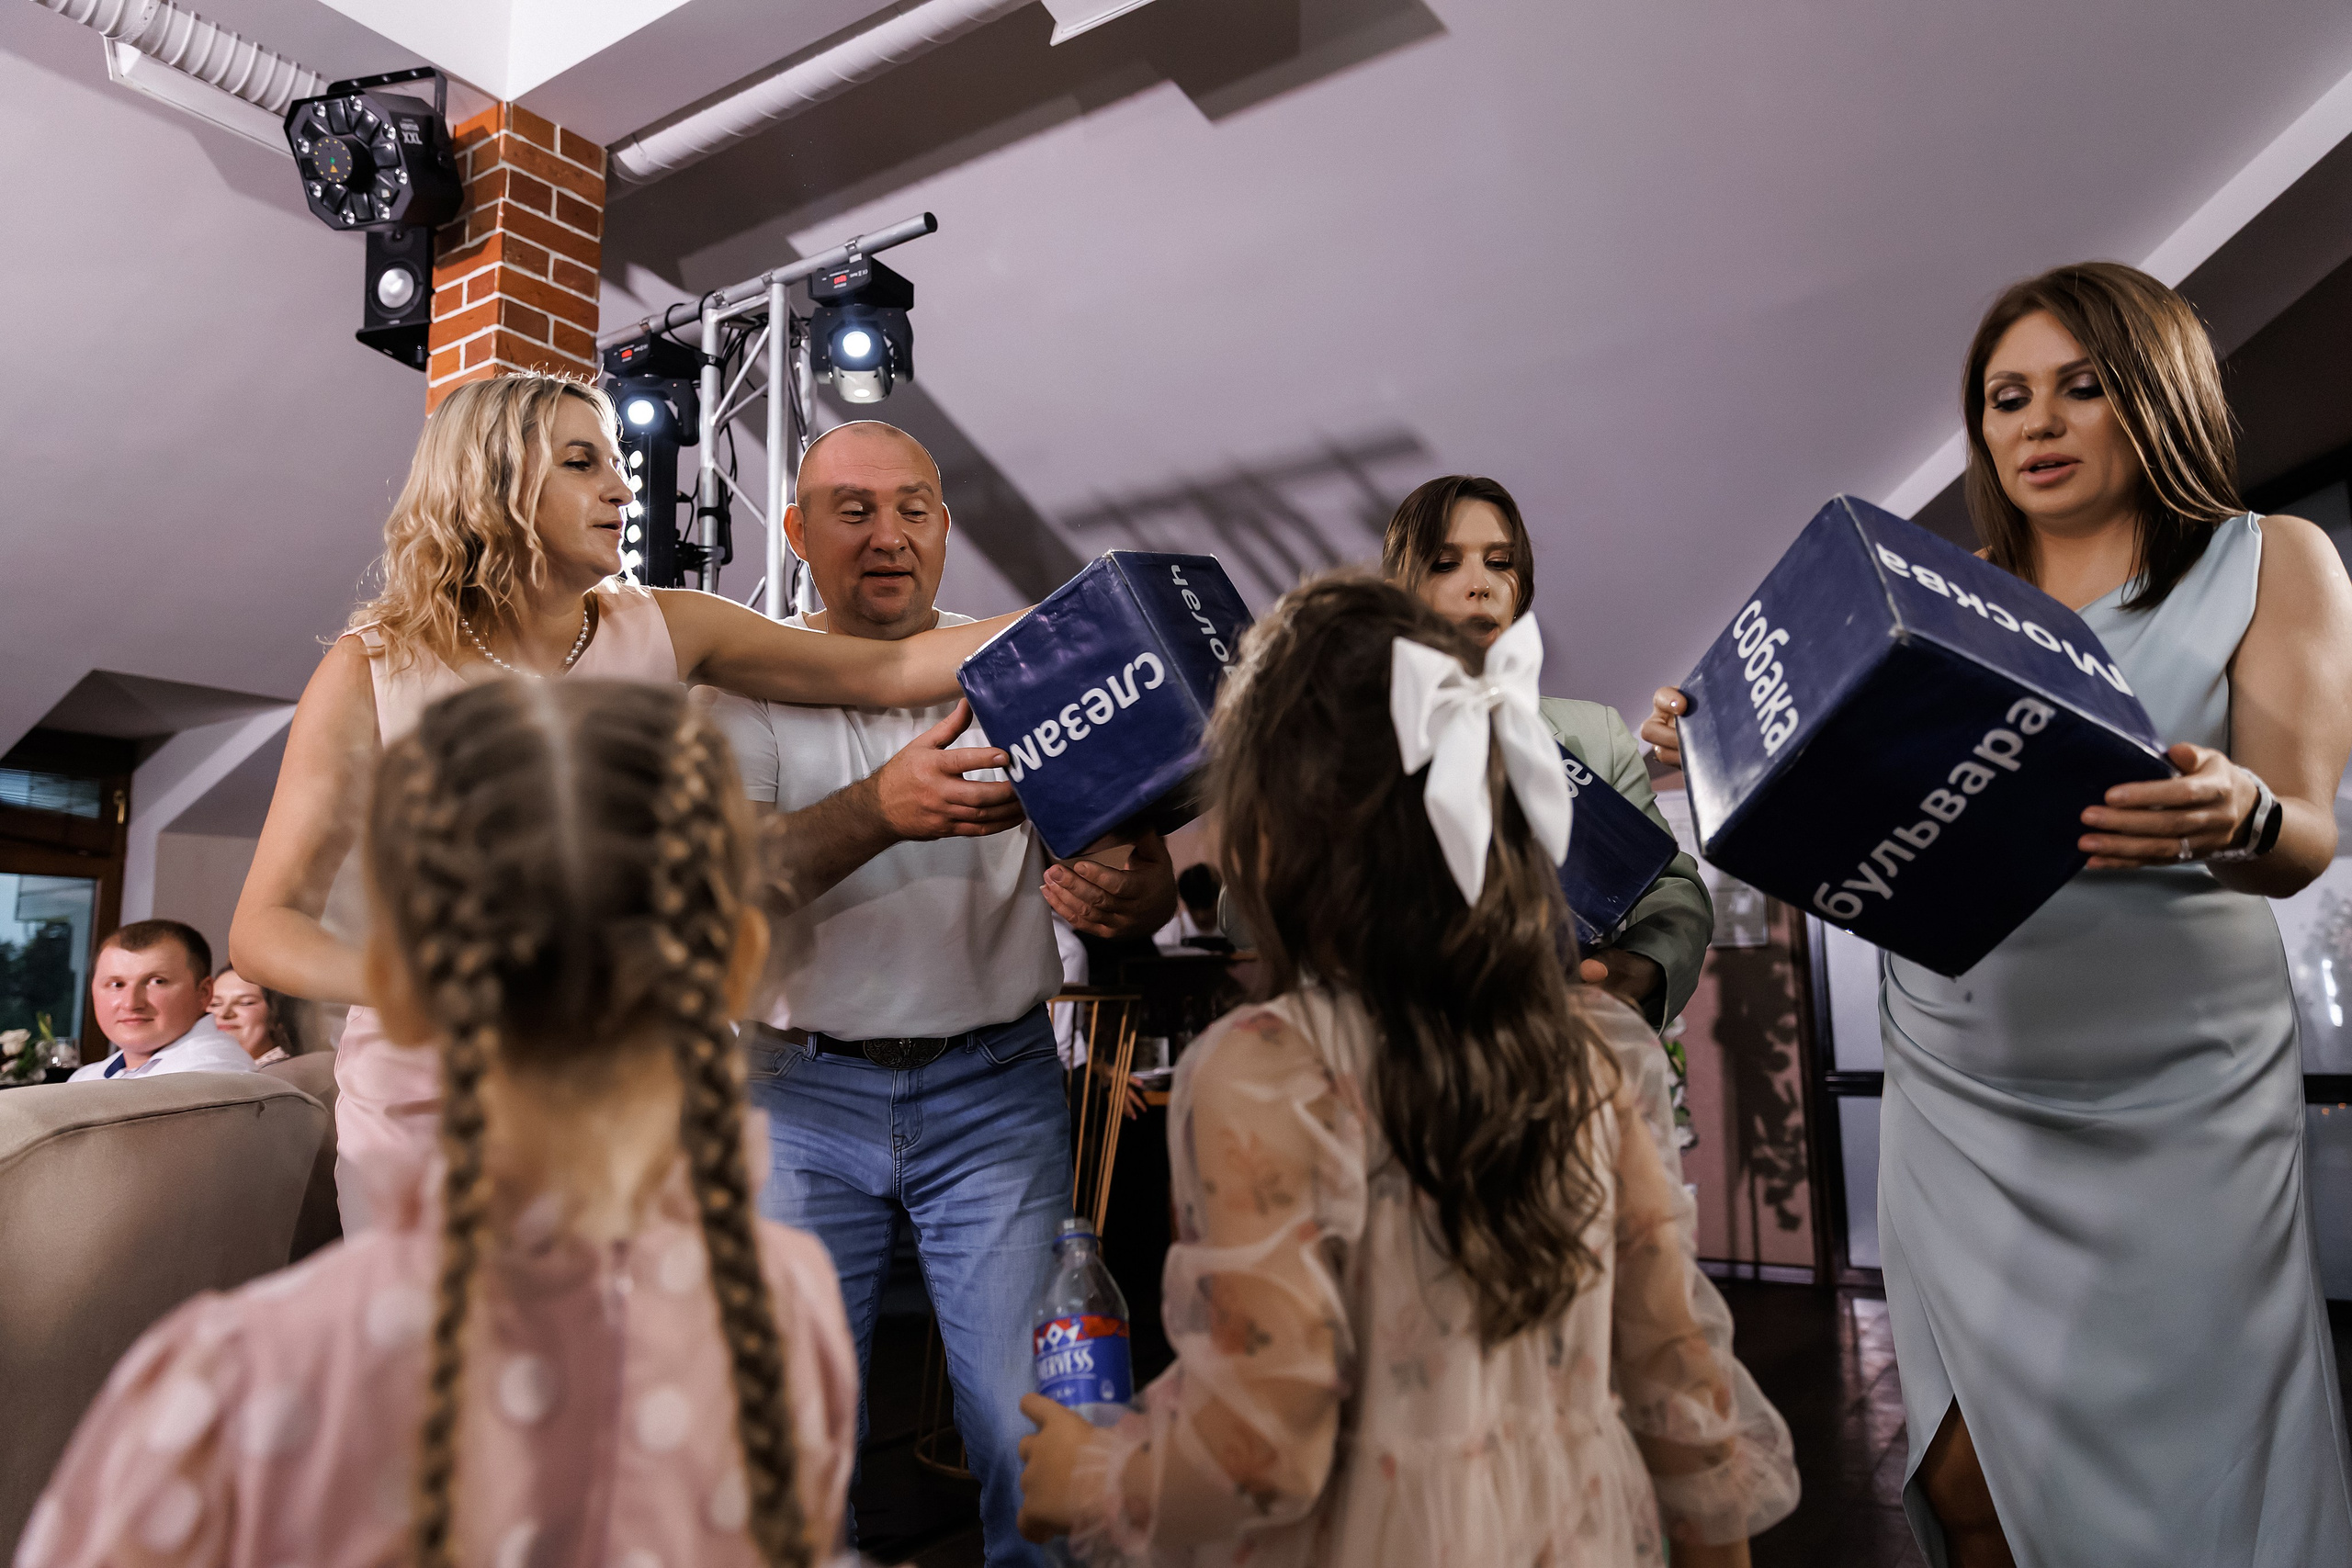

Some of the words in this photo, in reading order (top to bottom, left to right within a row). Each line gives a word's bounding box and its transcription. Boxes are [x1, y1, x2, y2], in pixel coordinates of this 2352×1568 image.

[1170, 564, 1238, 680] чело
[1732, 599, 1800, 758] собака
[1875, 541, 2134, 697] Москва
[1009, 651, 1166, 783] слезам
[1813, 695, 2057, 919] бульвара
